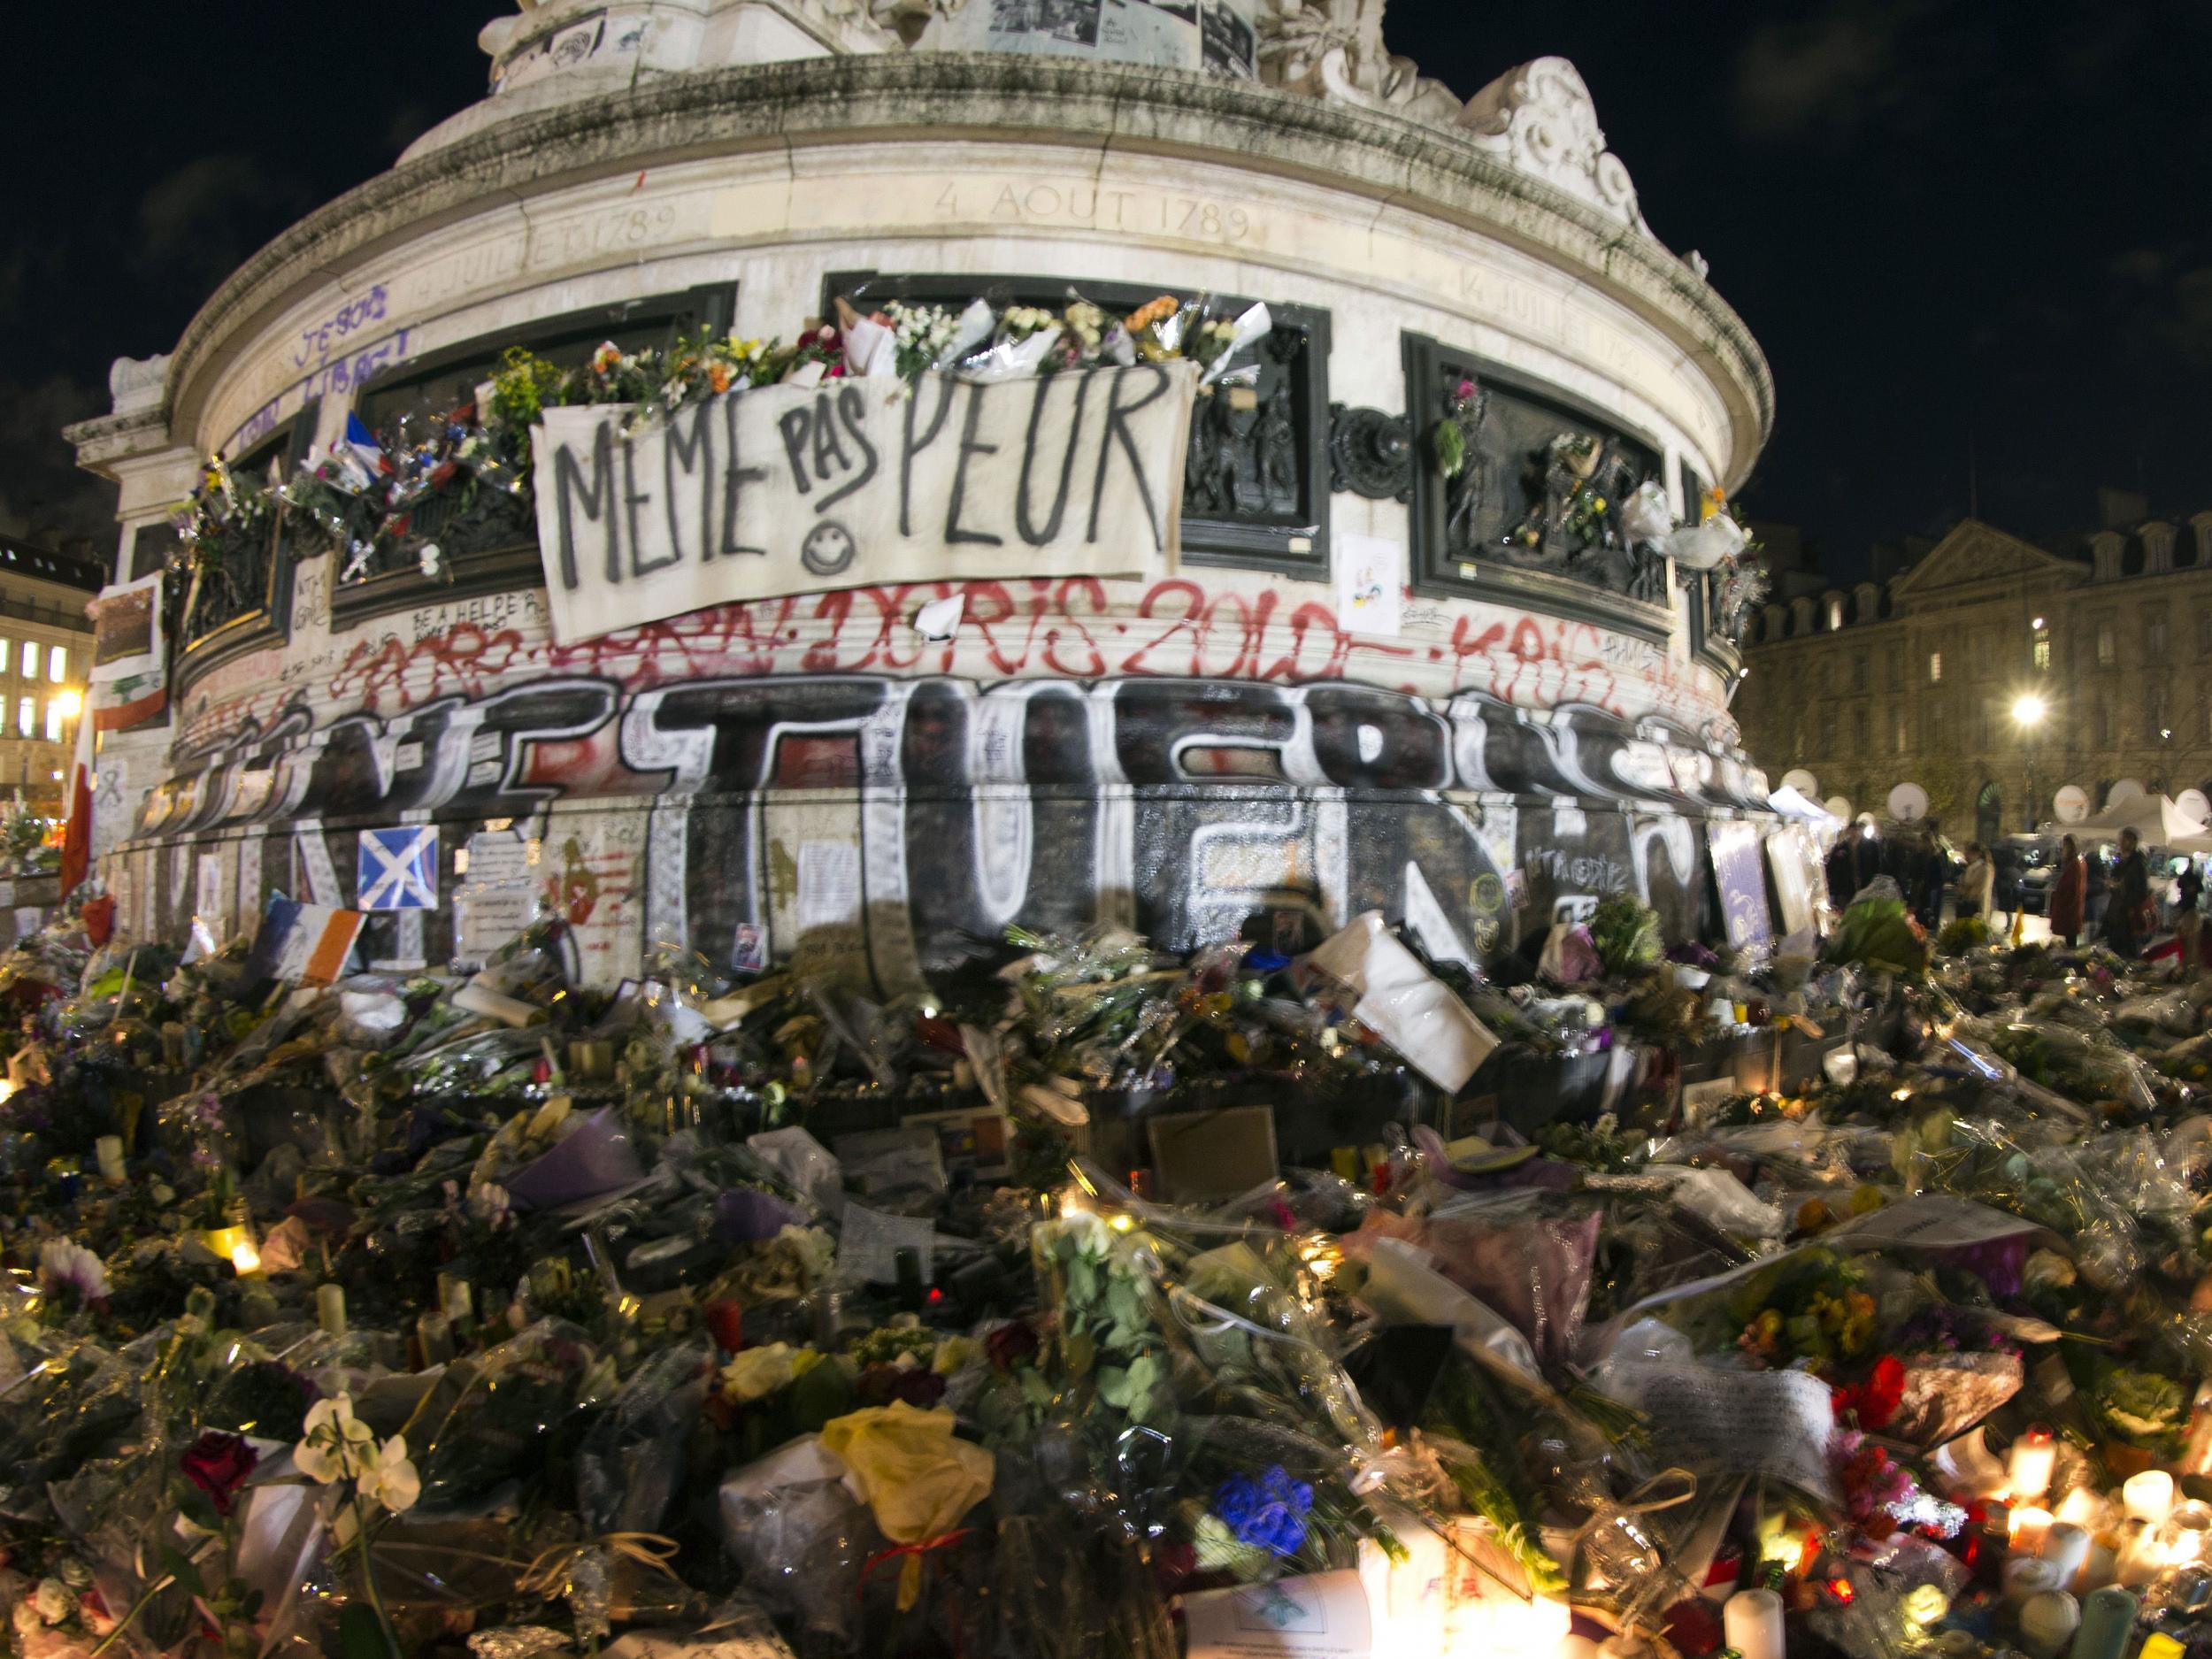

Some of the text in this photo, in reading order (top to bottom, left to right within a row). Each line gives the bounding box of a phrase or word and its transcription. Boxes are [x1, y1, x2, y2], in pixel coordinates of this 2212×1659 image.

[592, 204, 676, 251] 1789
[934, 181, 1250, 240] 4 AOUT 1789
[778, 387, 879, 513] PAS
[899, 365, 1171, 552] PEUR
[413, 608, 433, 631] BE
[438, 605, 448, 623] A
[456, 593, 537, 625] HELPER
